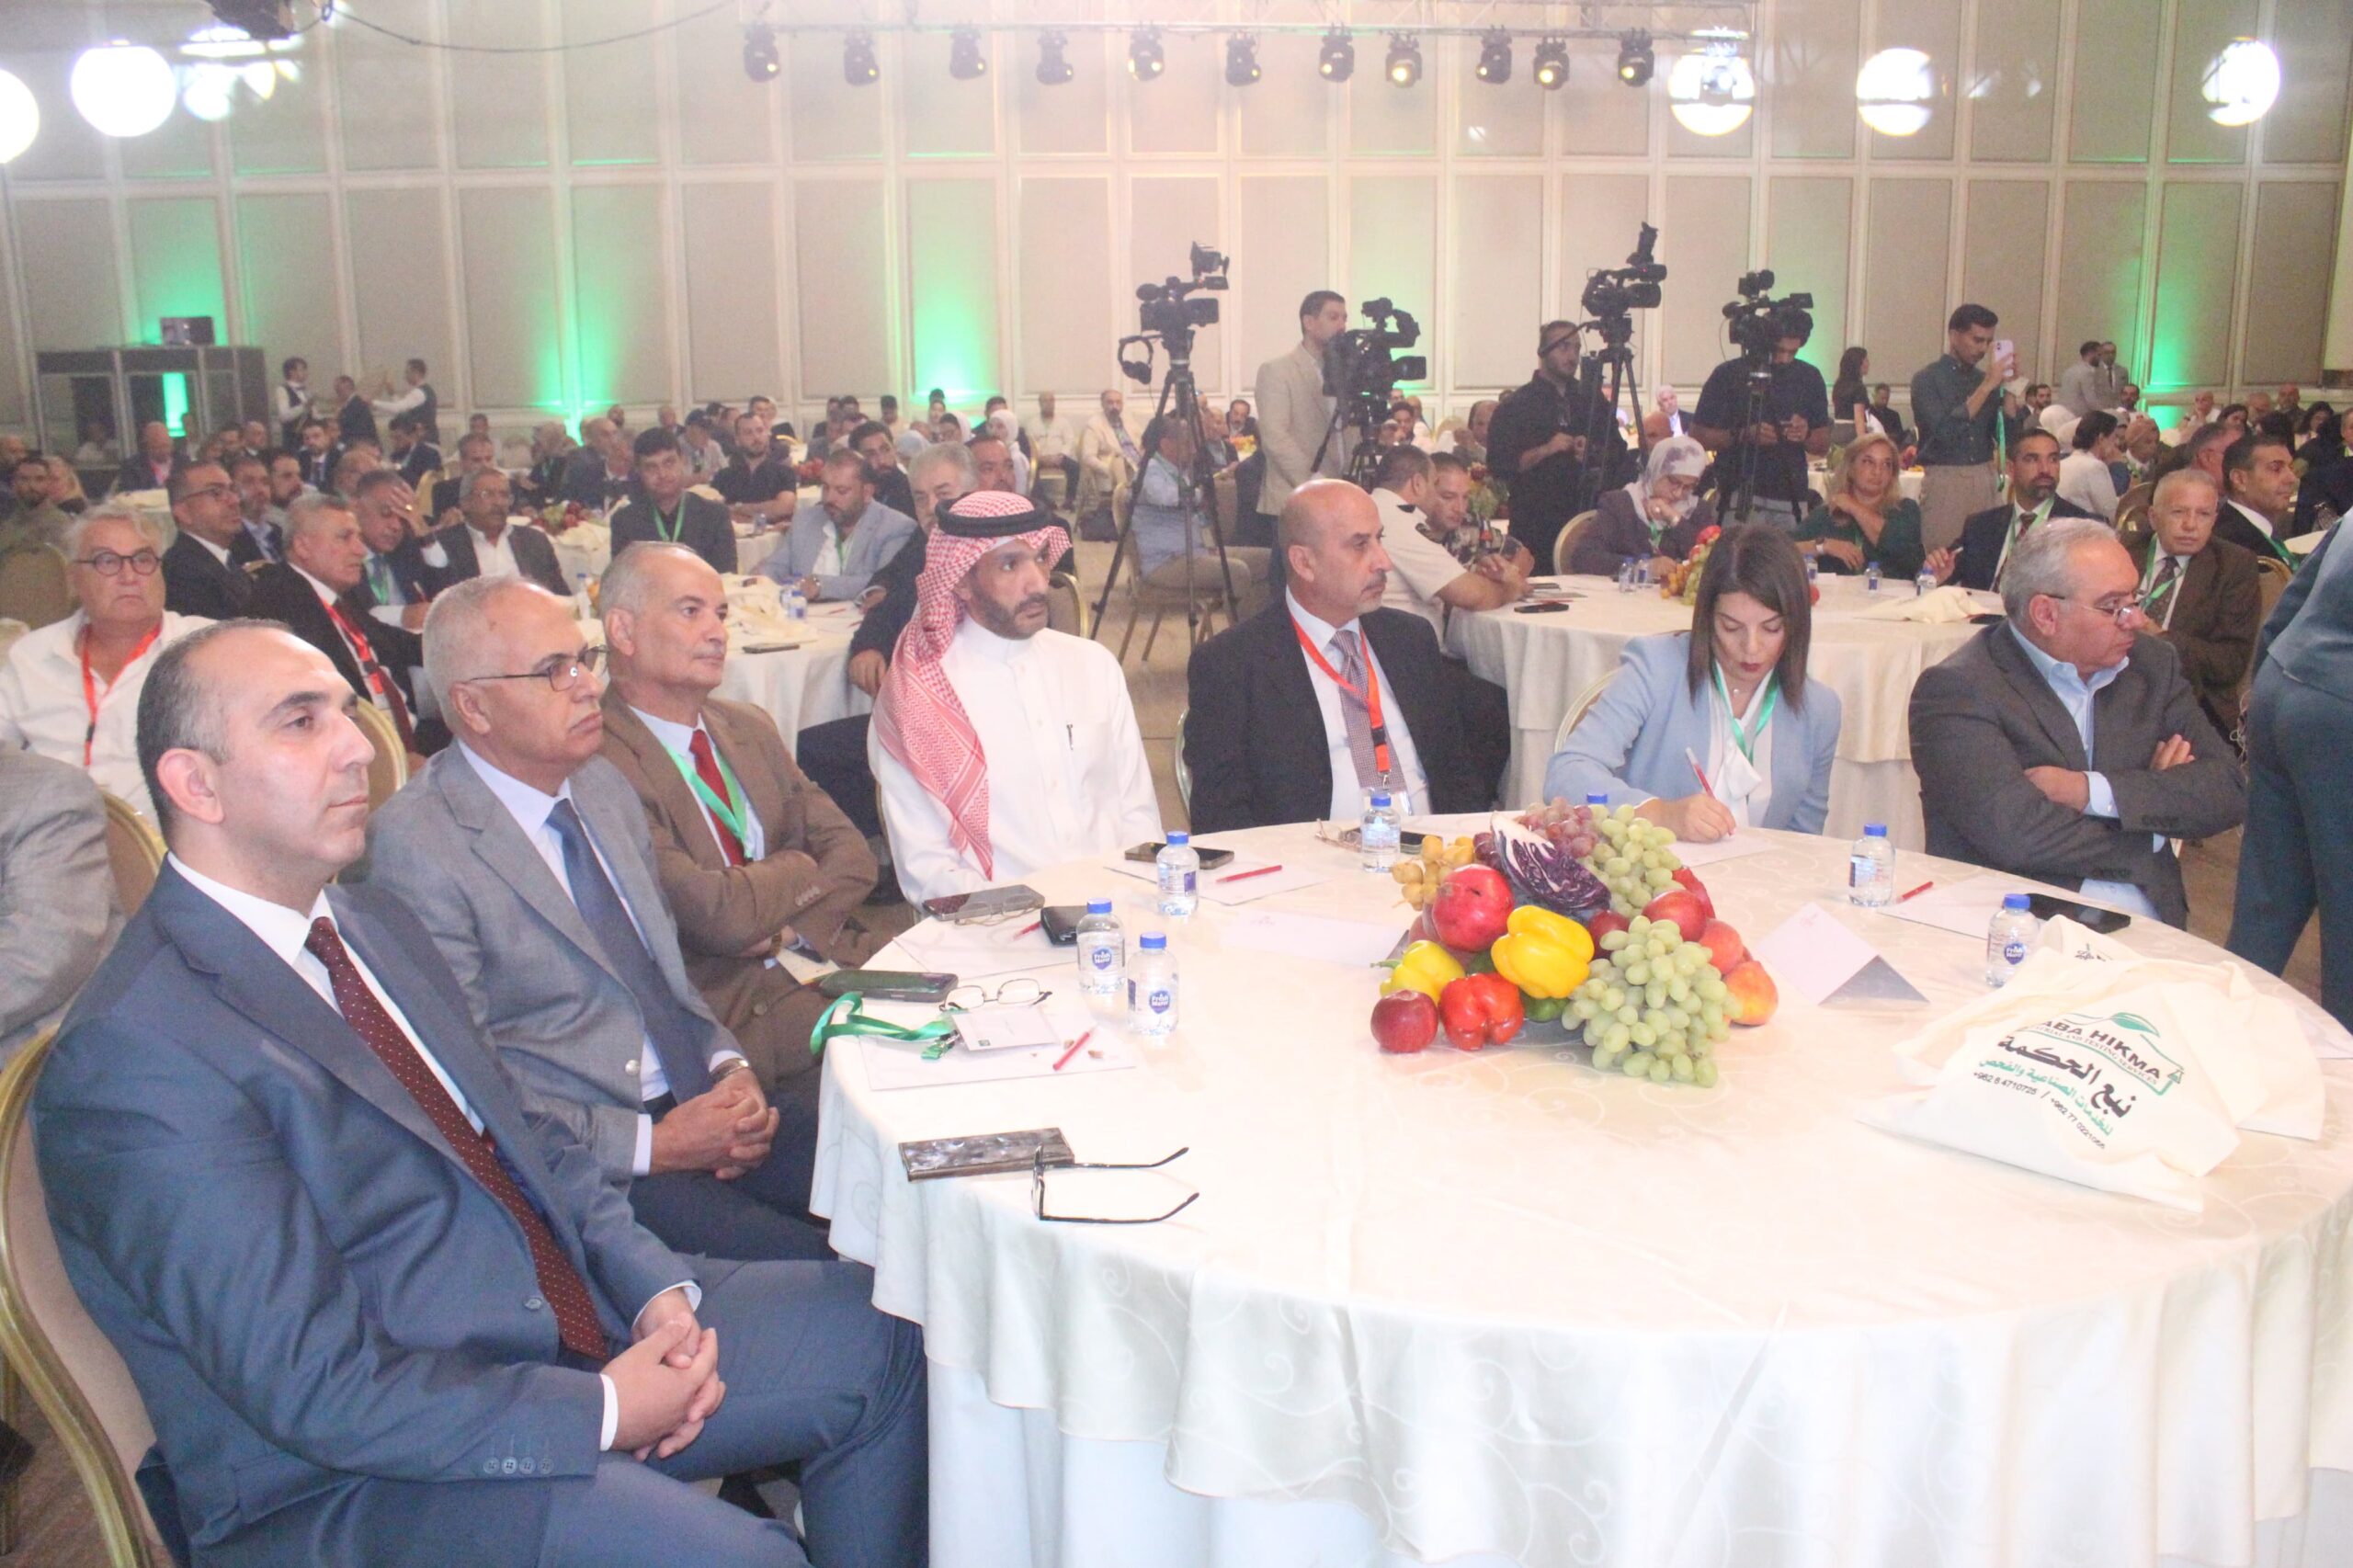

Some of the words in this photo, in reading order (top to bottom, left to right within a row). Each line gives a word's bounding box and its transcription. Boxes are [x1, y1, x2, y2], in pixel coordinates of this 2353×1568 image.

[1997, 1034, 2102, 1085] الحكمة
[2042, 1020, 2083, 1036] ABA
[2089, 1029, 2160, 1079] HIKMA
[2026, 1067, 2076, 1098] الصناعية
[2090, 1083, 2137, 1119] نبع
